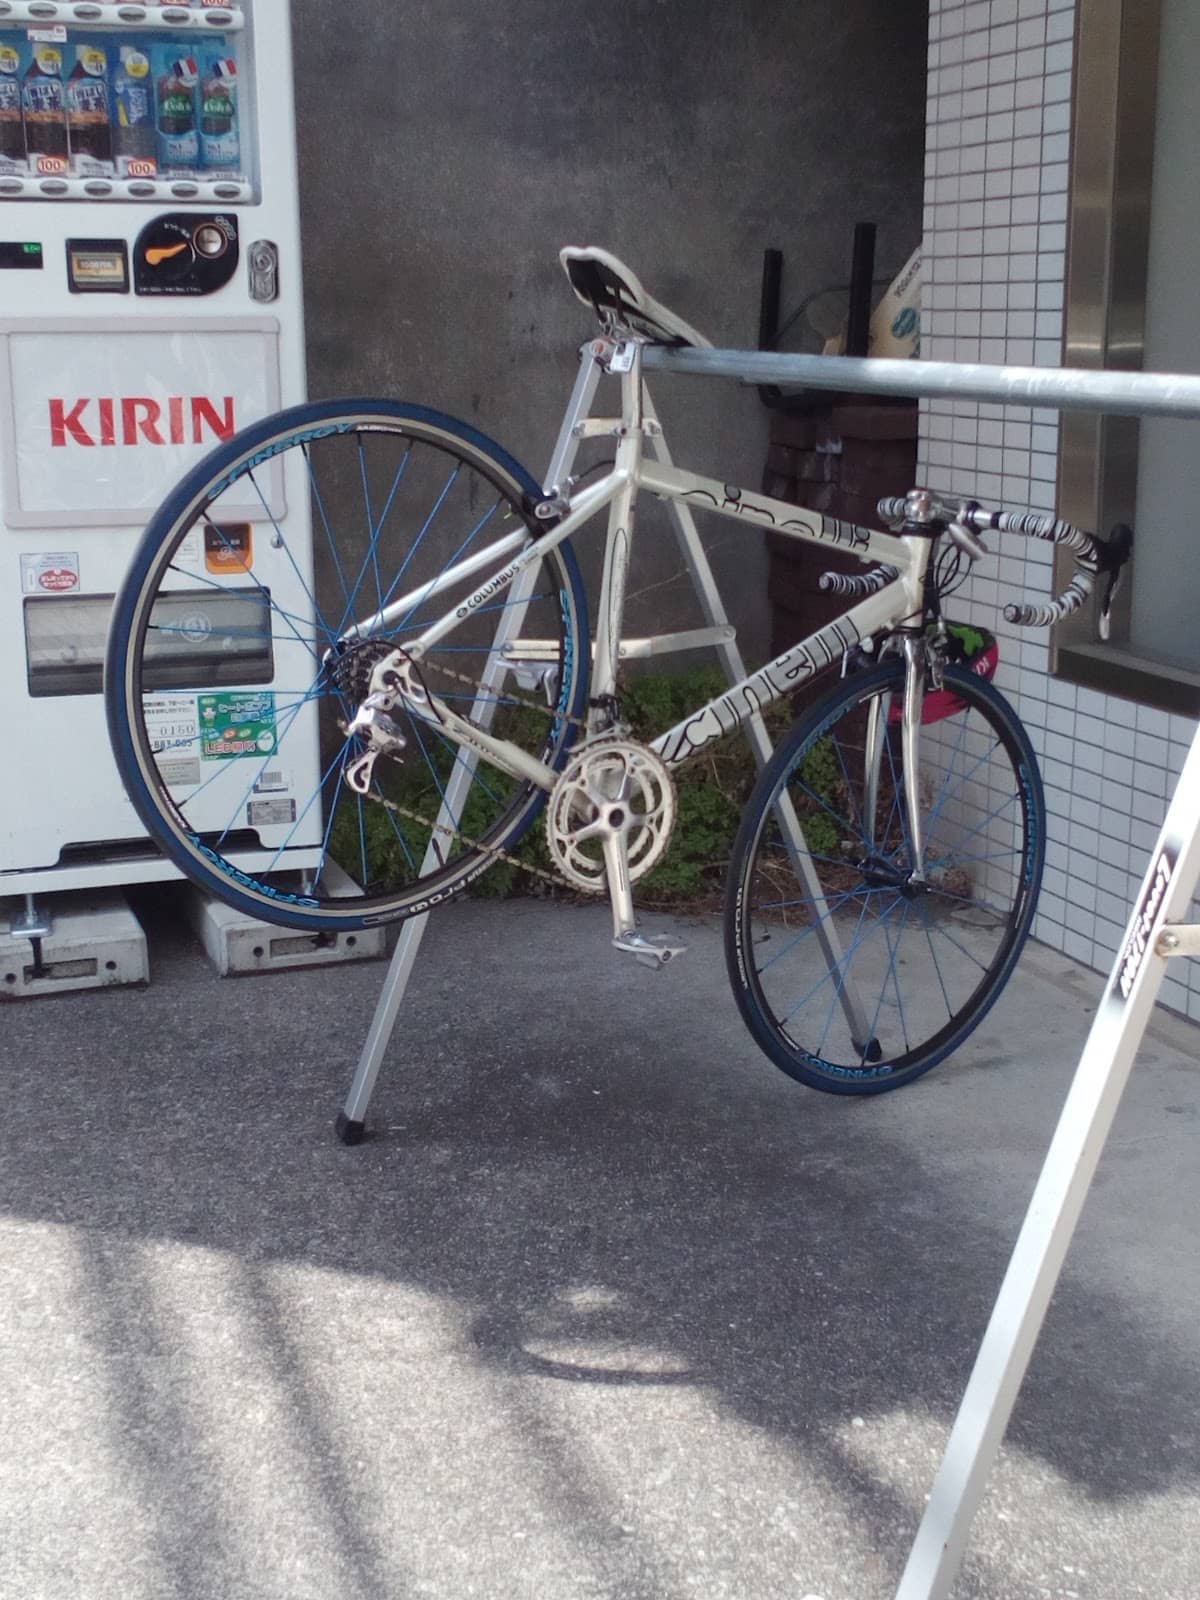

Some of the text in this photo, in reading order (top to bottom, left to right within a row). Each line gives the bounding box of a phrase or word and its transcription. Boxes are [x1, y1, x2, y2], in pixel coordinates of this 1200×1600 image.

[40, 161, 60, 171] 100
[130, 162, 151, 174] 100
[48, 396, 236, 447] KIRIN
[467, 562, 520, 608] COLUMBUS
[186, 833, 320, 908] SPINERGY
